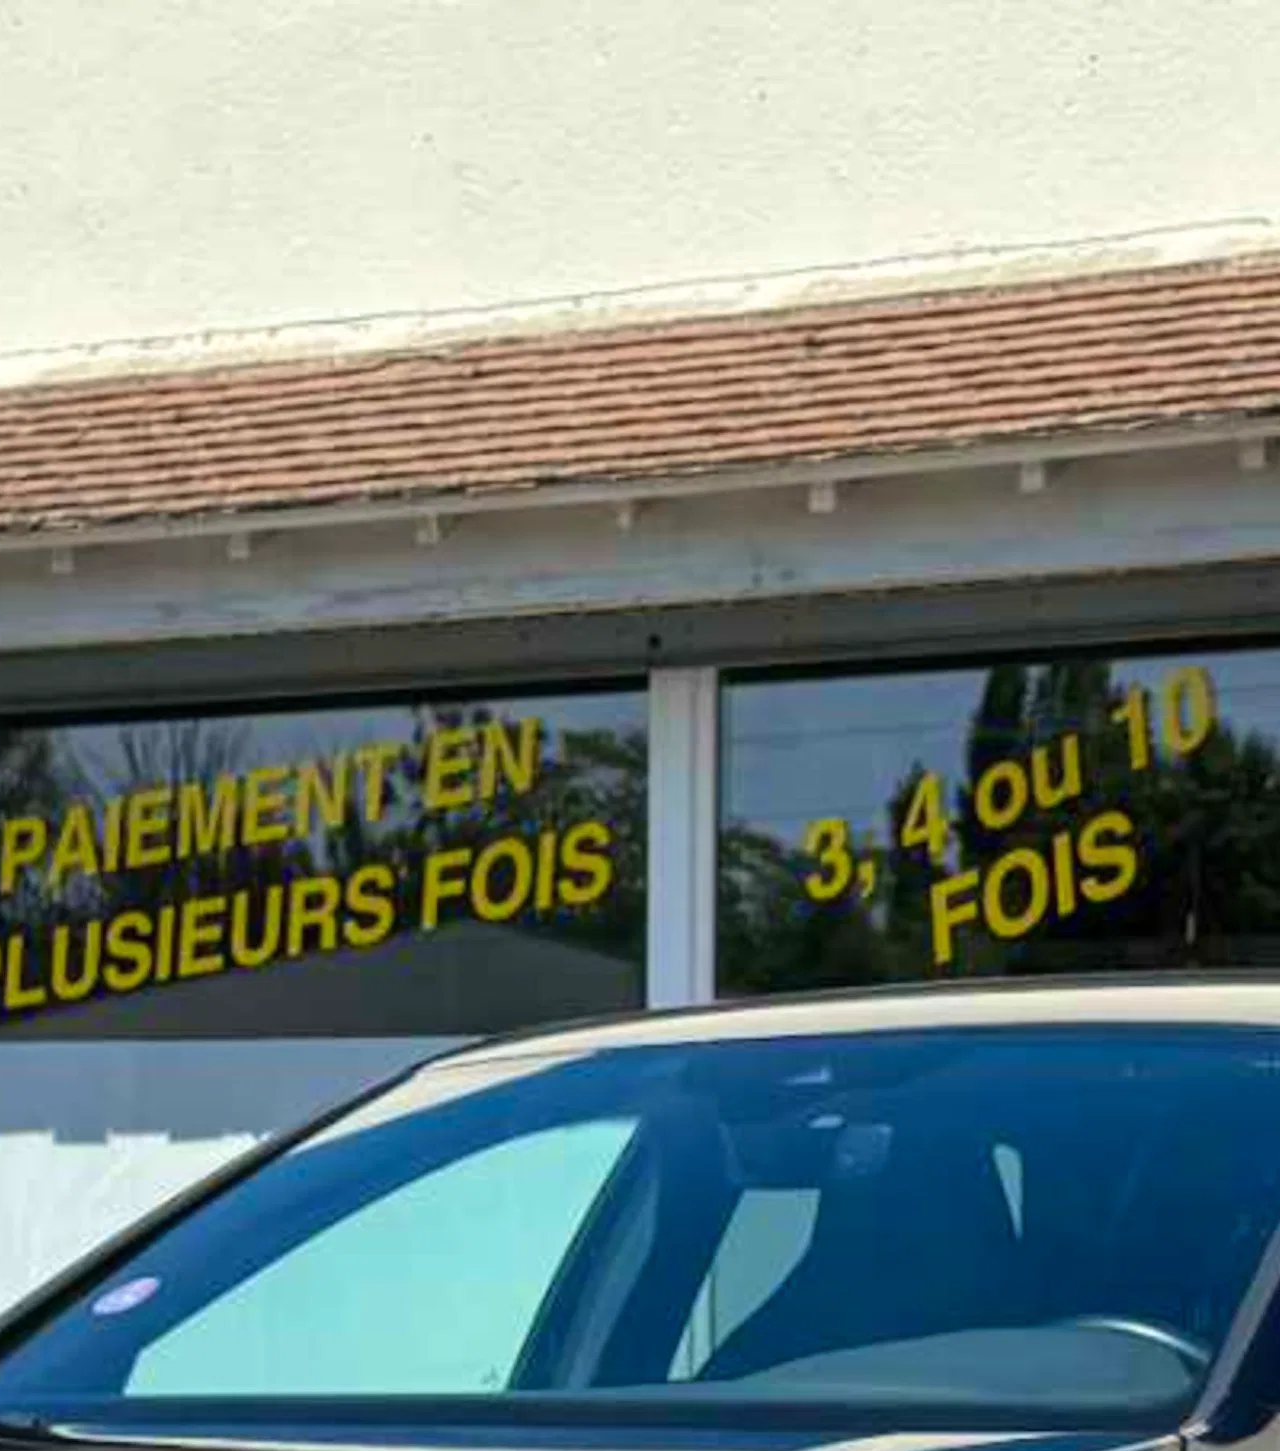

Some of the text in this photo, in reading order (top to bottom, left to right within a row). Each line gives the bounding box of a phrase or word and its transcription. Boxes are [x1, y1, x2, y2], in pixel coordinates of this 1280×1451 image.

[423, 716, 543, 812] EN
[803, 664, 1219, 903] 3, 4 ou 10
[421, 818, 614, 931] FOIS
[928, 810, 1138, 966] FOIS
